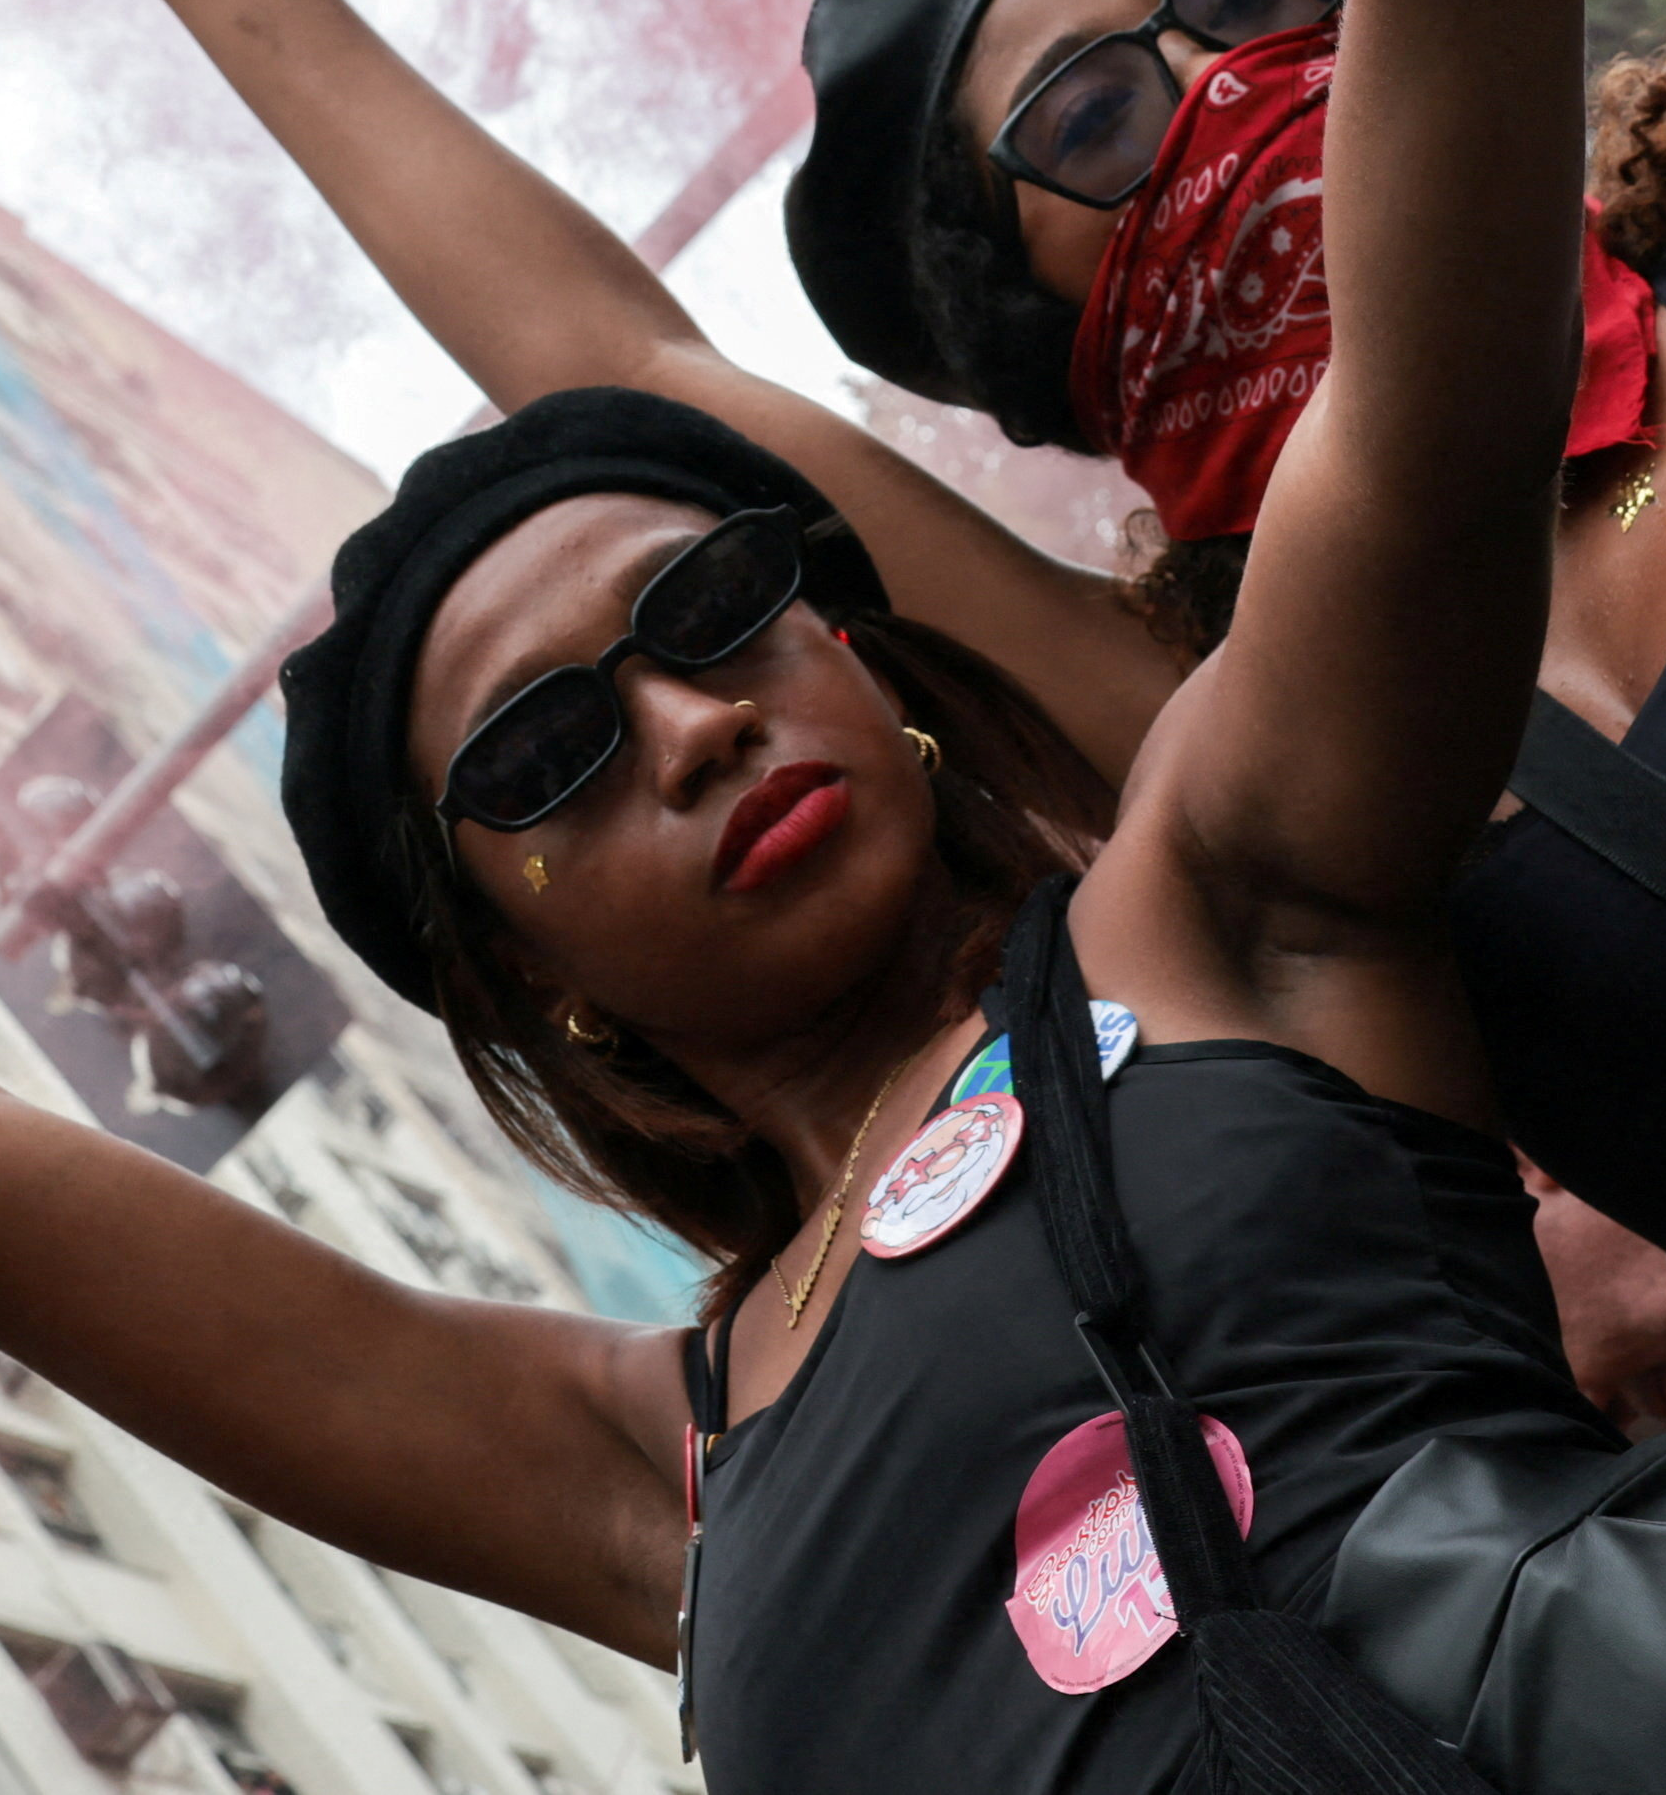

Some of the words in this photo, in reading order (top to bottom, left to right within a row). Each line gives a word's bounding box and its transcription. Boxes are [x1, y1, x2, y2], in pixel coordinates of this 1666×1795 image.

[1098, 1011, 1137, 1062] ES
[1024, 1471, 1137, 1614] Gostos
[1051, 1495, 1158, 1656] Lul
[1087, 1504, 1133, 1557] com
